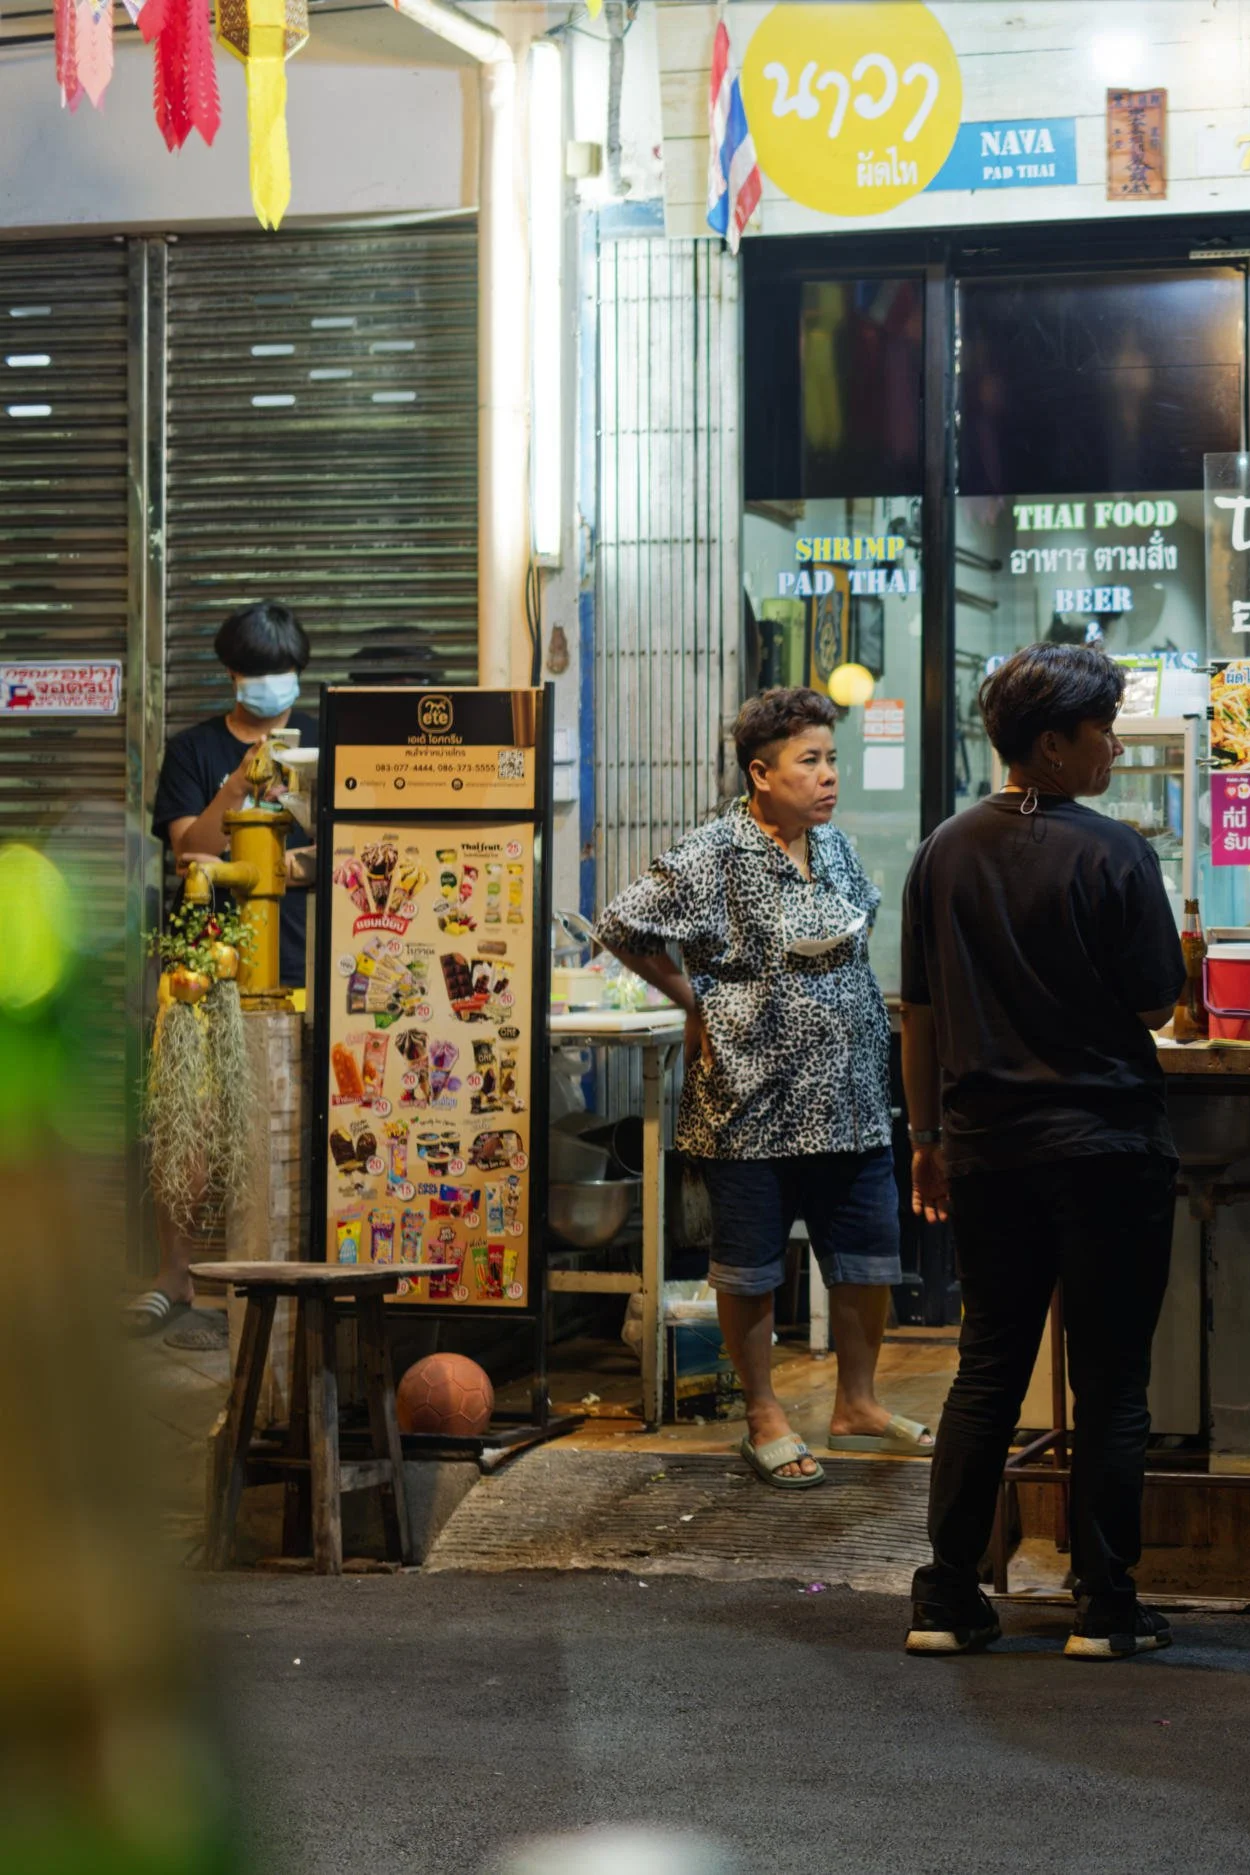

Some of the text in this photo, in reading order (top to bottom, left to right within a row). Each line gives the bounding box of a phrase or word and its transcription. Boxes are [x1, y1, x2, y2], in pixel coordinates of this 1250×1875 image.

[763, 52, 940, 142] นาวา
[980, 128, 1056, 157] NAVA
[983, 163, 1056, 180] PAD THAI
[1014, 500, 1178, 531] THAI FOOD
[796, 536, 906, 561] SHRIMP
[1010, 531, 1178, 575] อาหาร ตามสั่ง
[777, 568, 918, 597] PAD THAI
[1055, 586, 1133, 613] BEER
